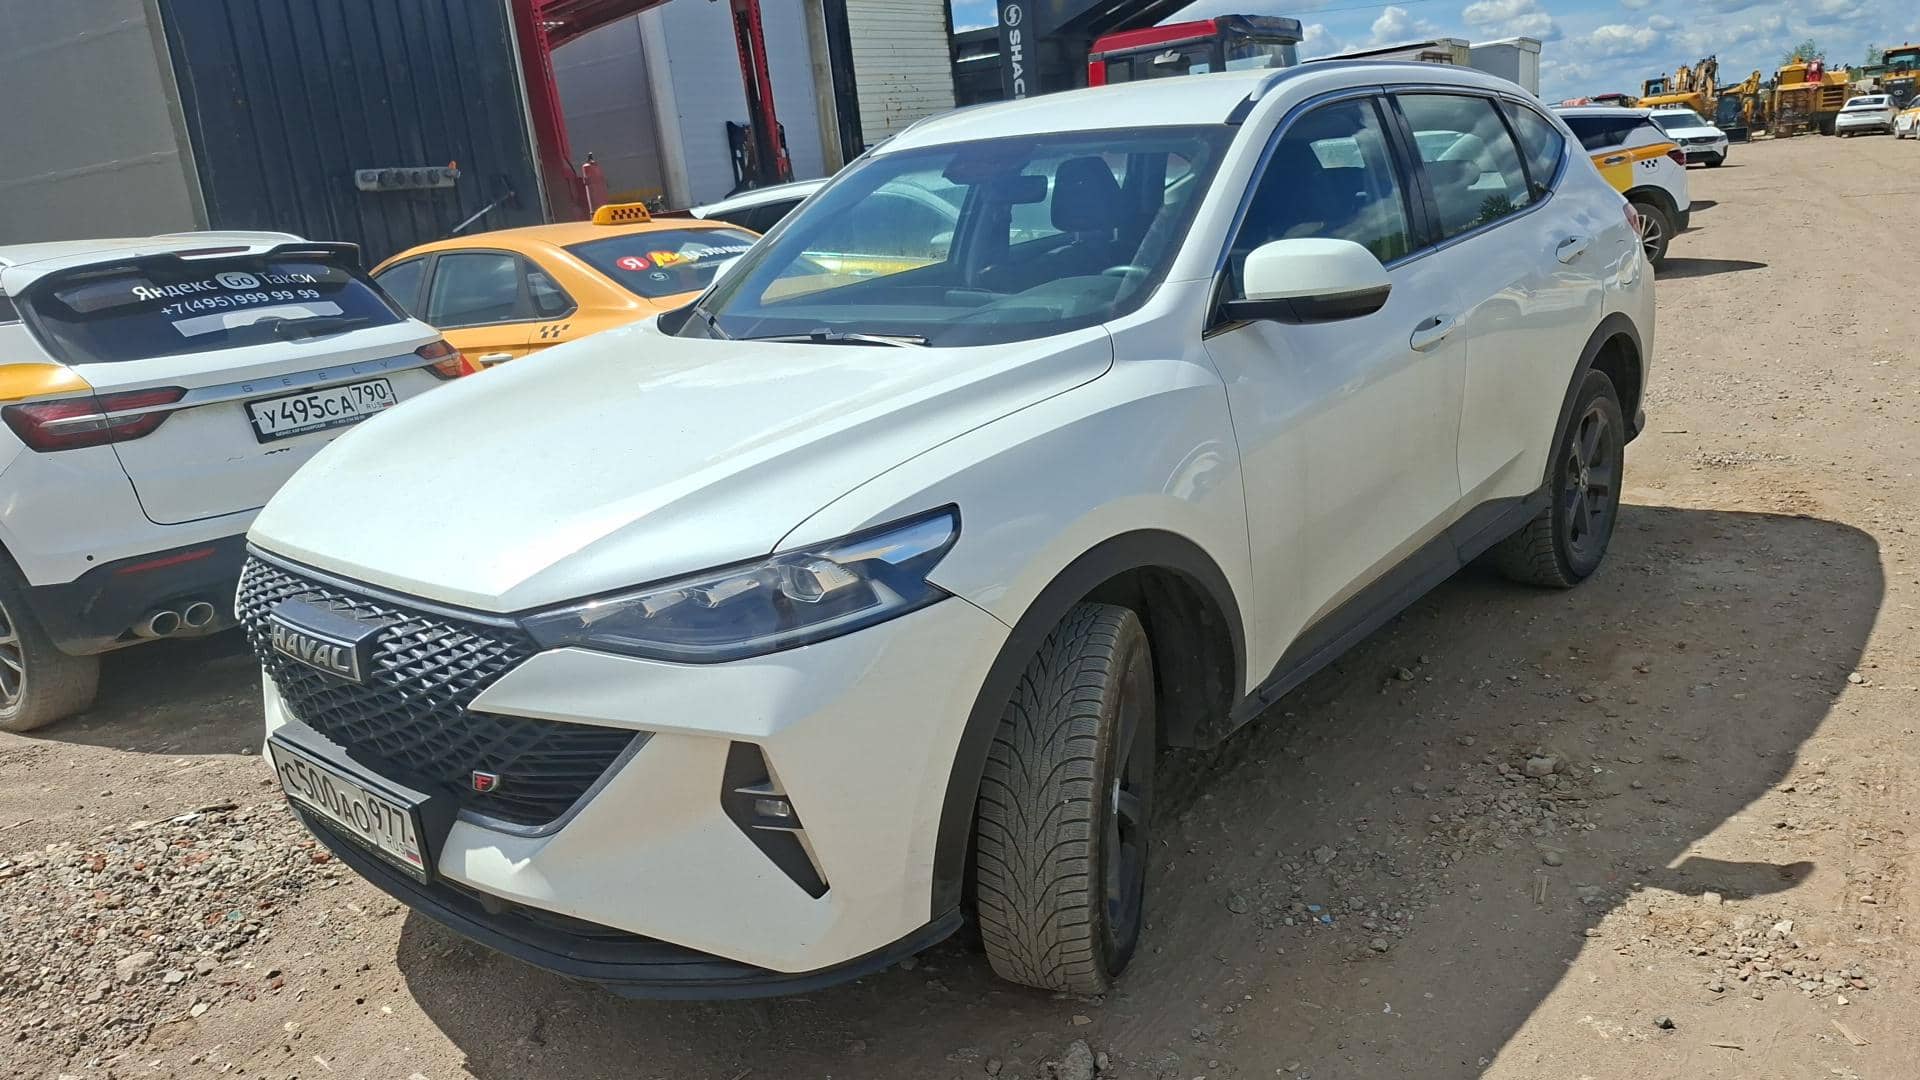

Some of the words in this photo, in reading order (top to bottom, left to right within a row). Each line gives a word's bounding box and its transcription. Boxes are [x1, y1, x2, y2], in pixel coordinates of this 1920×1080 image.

[131, 279, 217, 301] Яндекс
[223, 274, 256, 289] Go
[255, 271, 318, 286] Такси
[241, 361, 390, 394] GEELY
[271, 624, 350, 673] HAVAL
